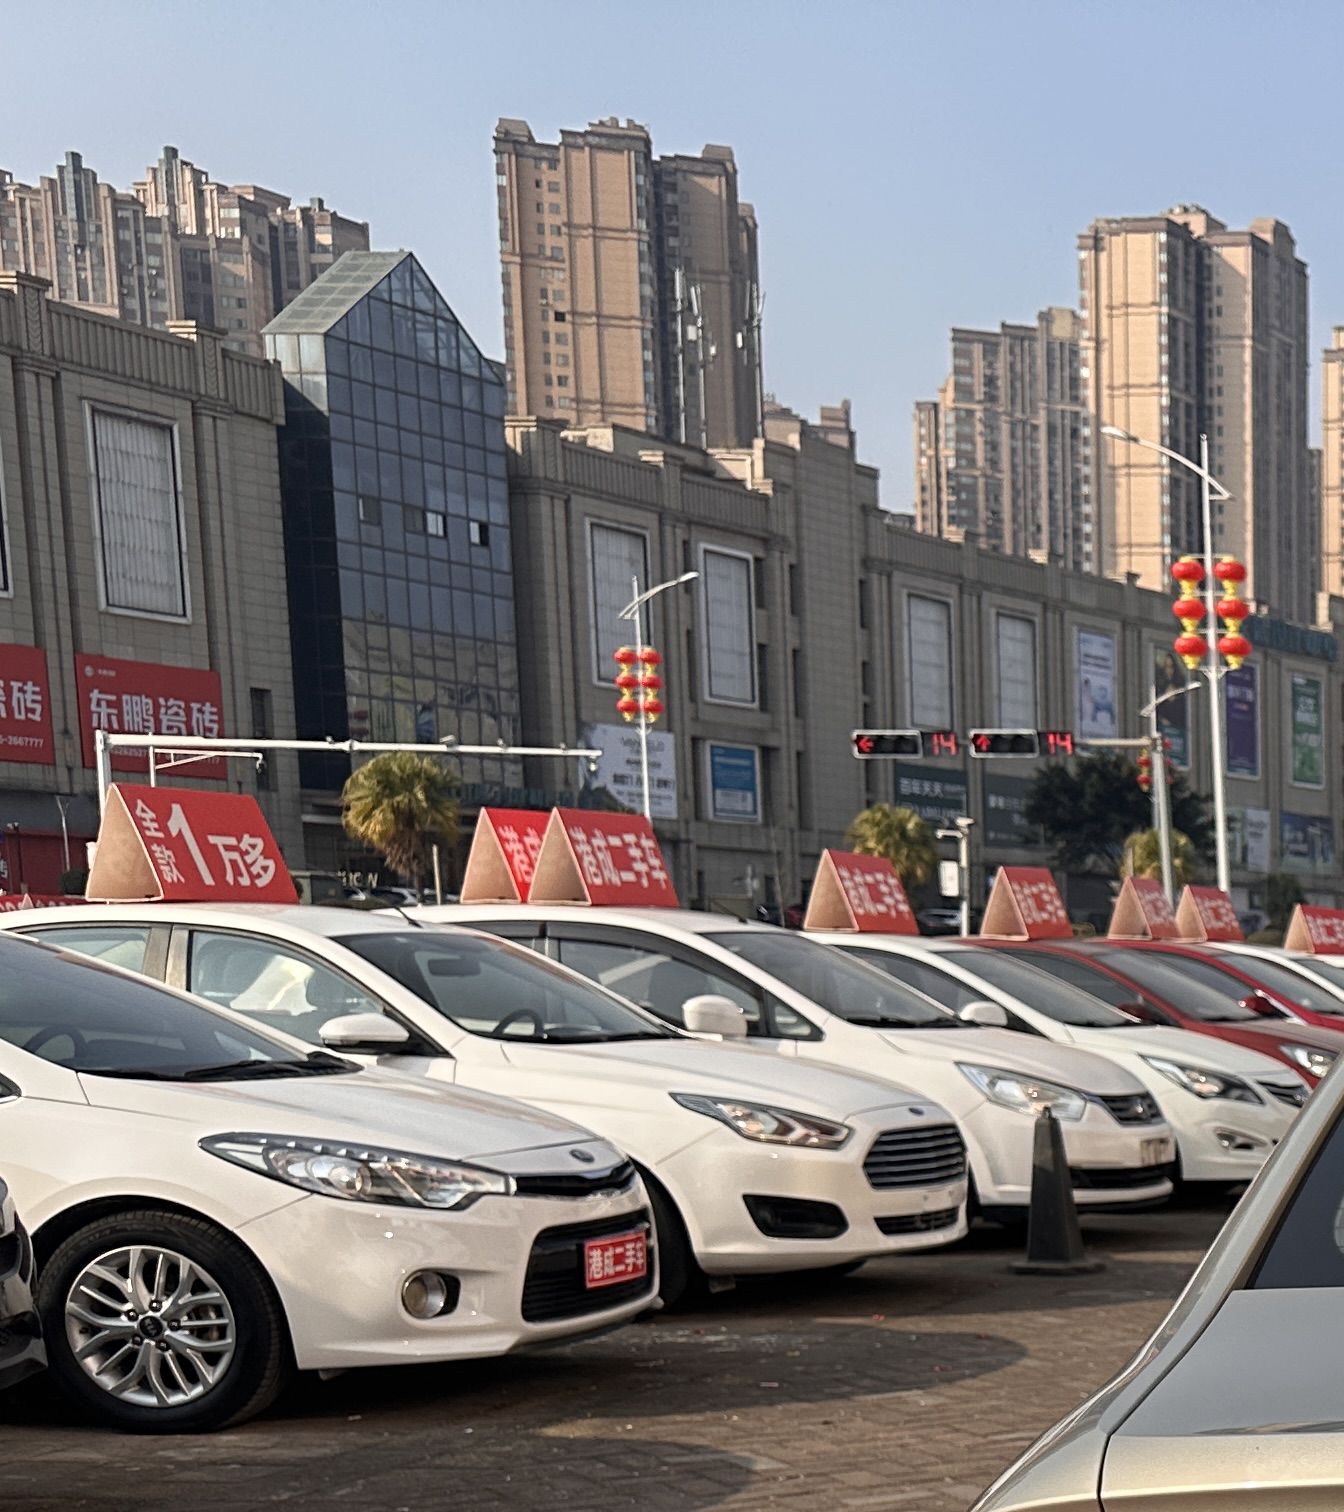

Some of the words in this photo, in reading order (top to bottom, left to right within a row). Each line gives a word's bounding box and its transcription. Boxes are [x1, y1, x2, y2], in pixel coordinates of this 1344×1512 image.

[0, 680, 42, 722] 砖
[90, 688, 219, 739] 东鹏瓷砖
[931, 732, 958, 756] 14
[1047, 732, 1073, 755] 14
